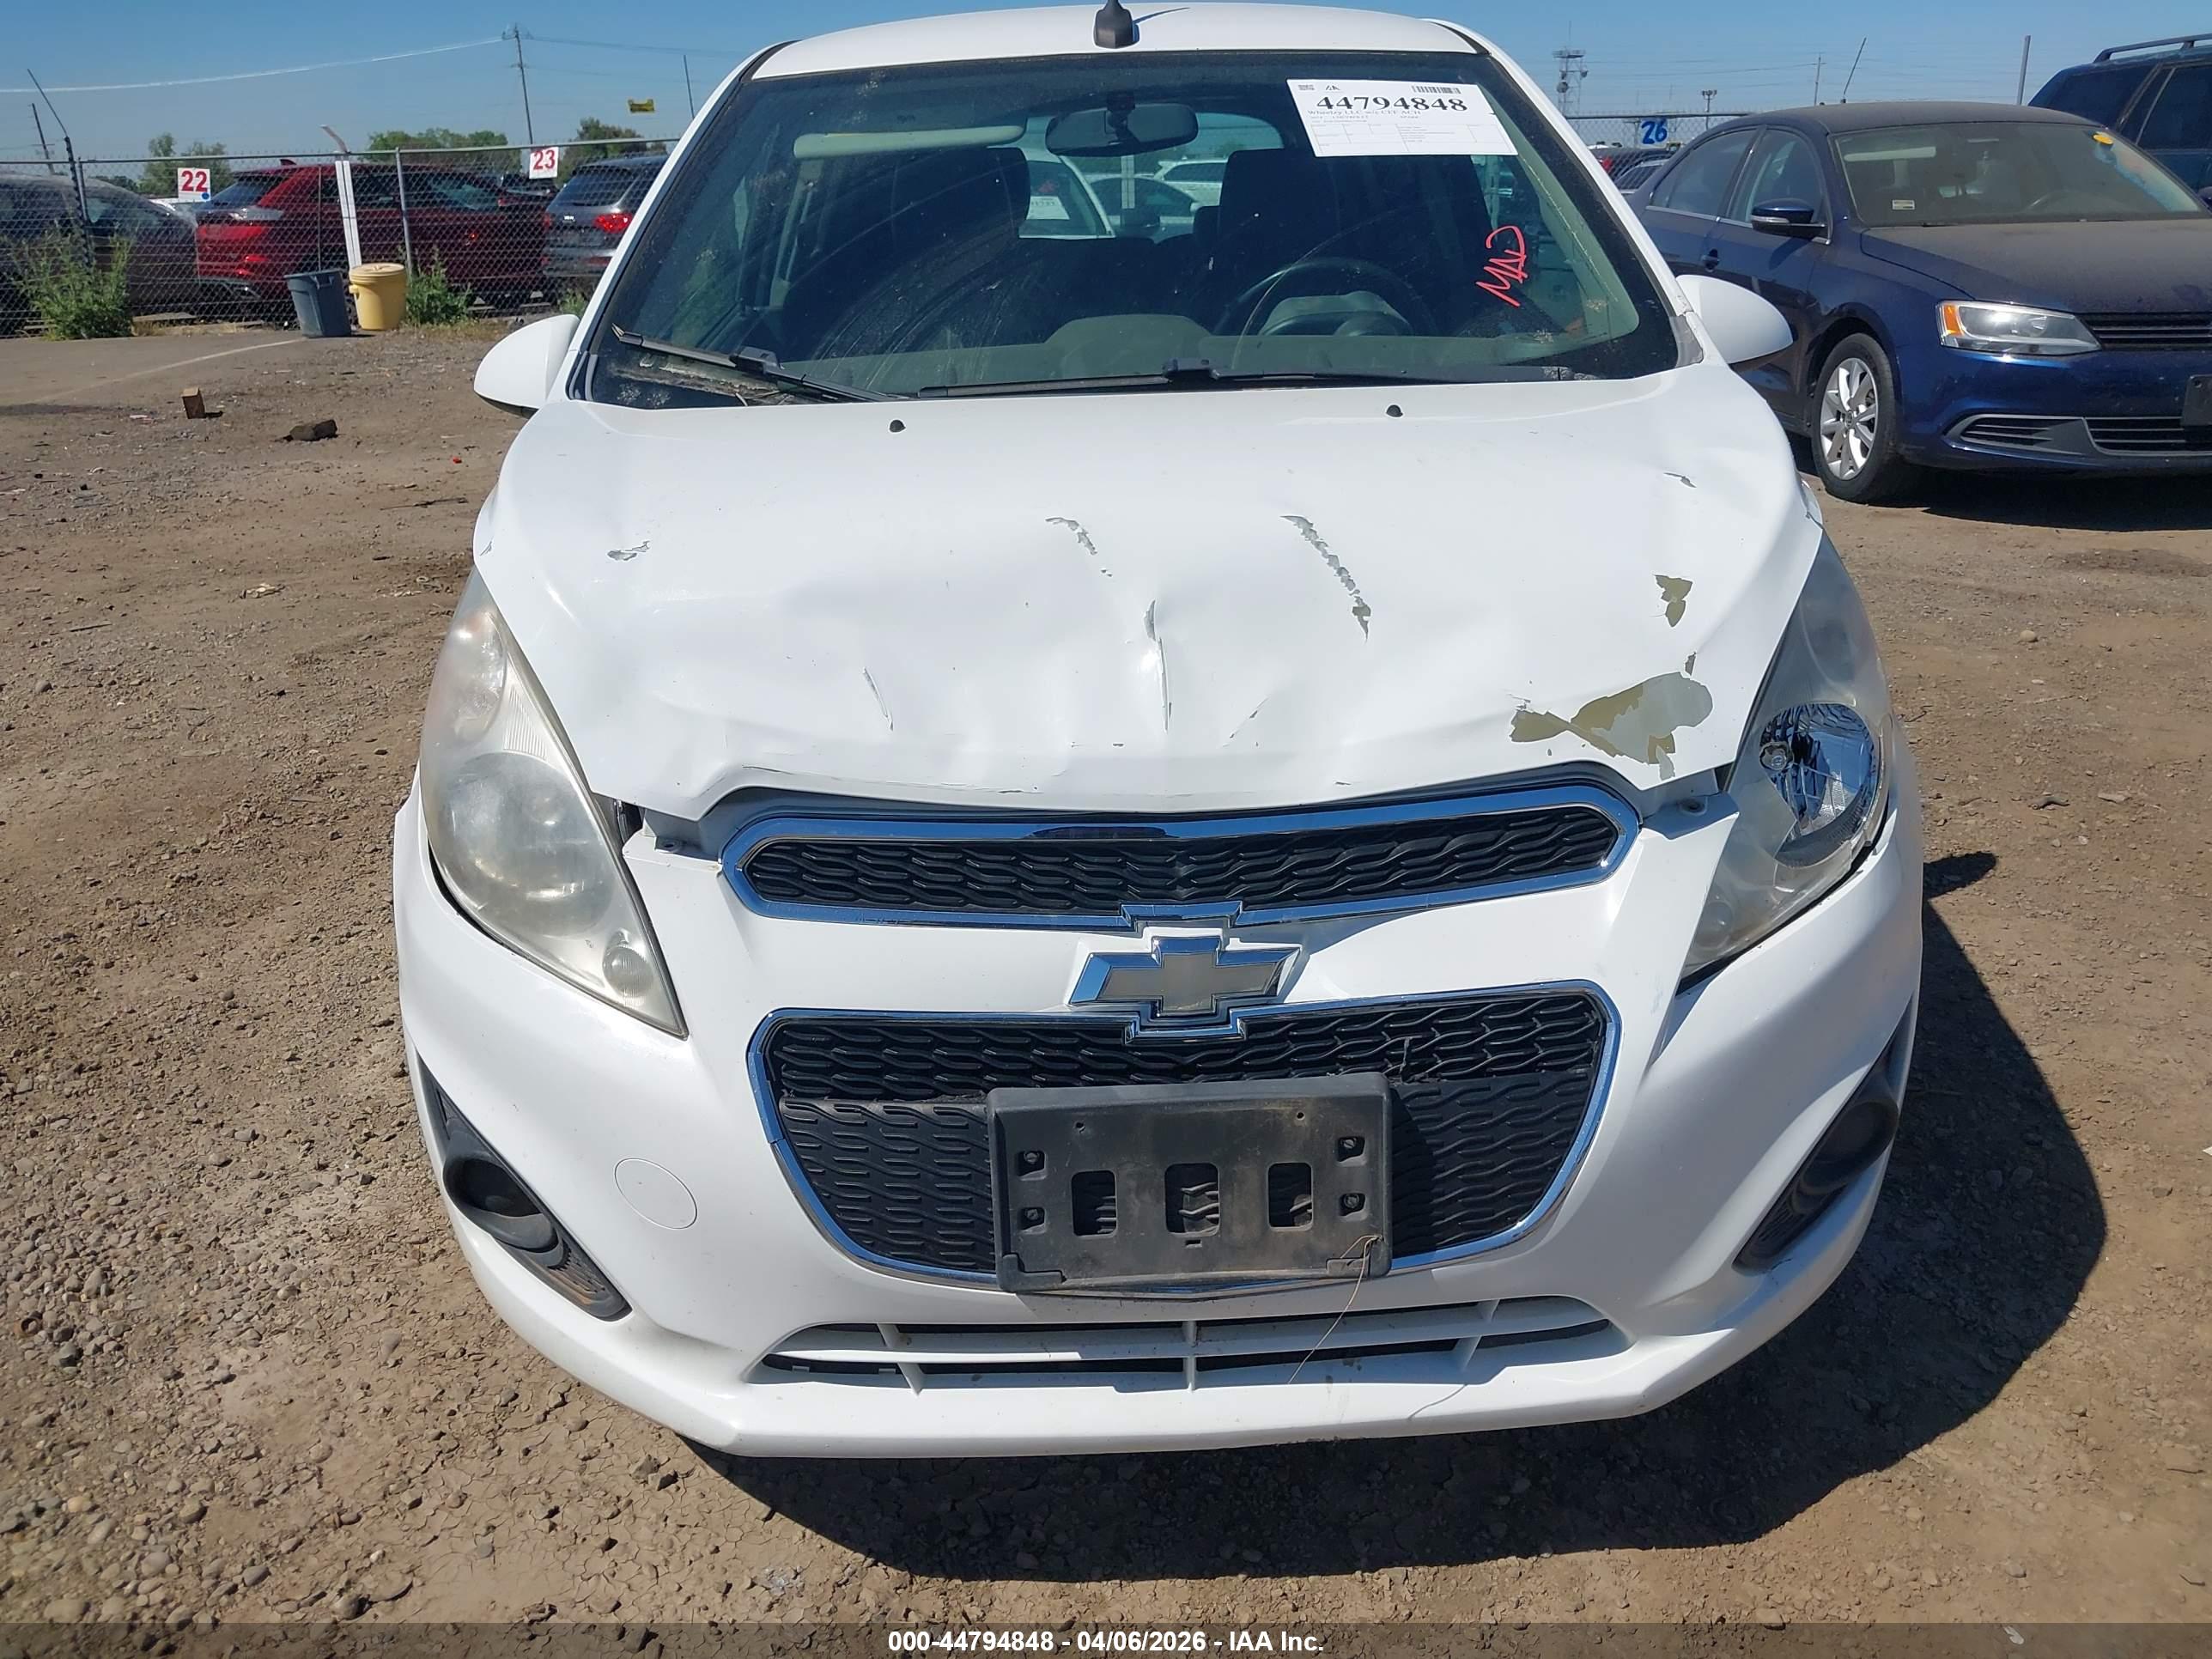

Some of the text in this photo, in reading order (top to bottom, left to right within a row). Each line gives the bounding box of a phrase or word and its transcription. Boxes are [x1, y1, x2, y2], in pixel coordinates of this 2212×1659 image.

[1316, 96, 1468, 111] 44794848
[1641, 118, 1668, 144] 26
[533, 149, 556, 170] 23
[181, 171, 208, 191] 22
